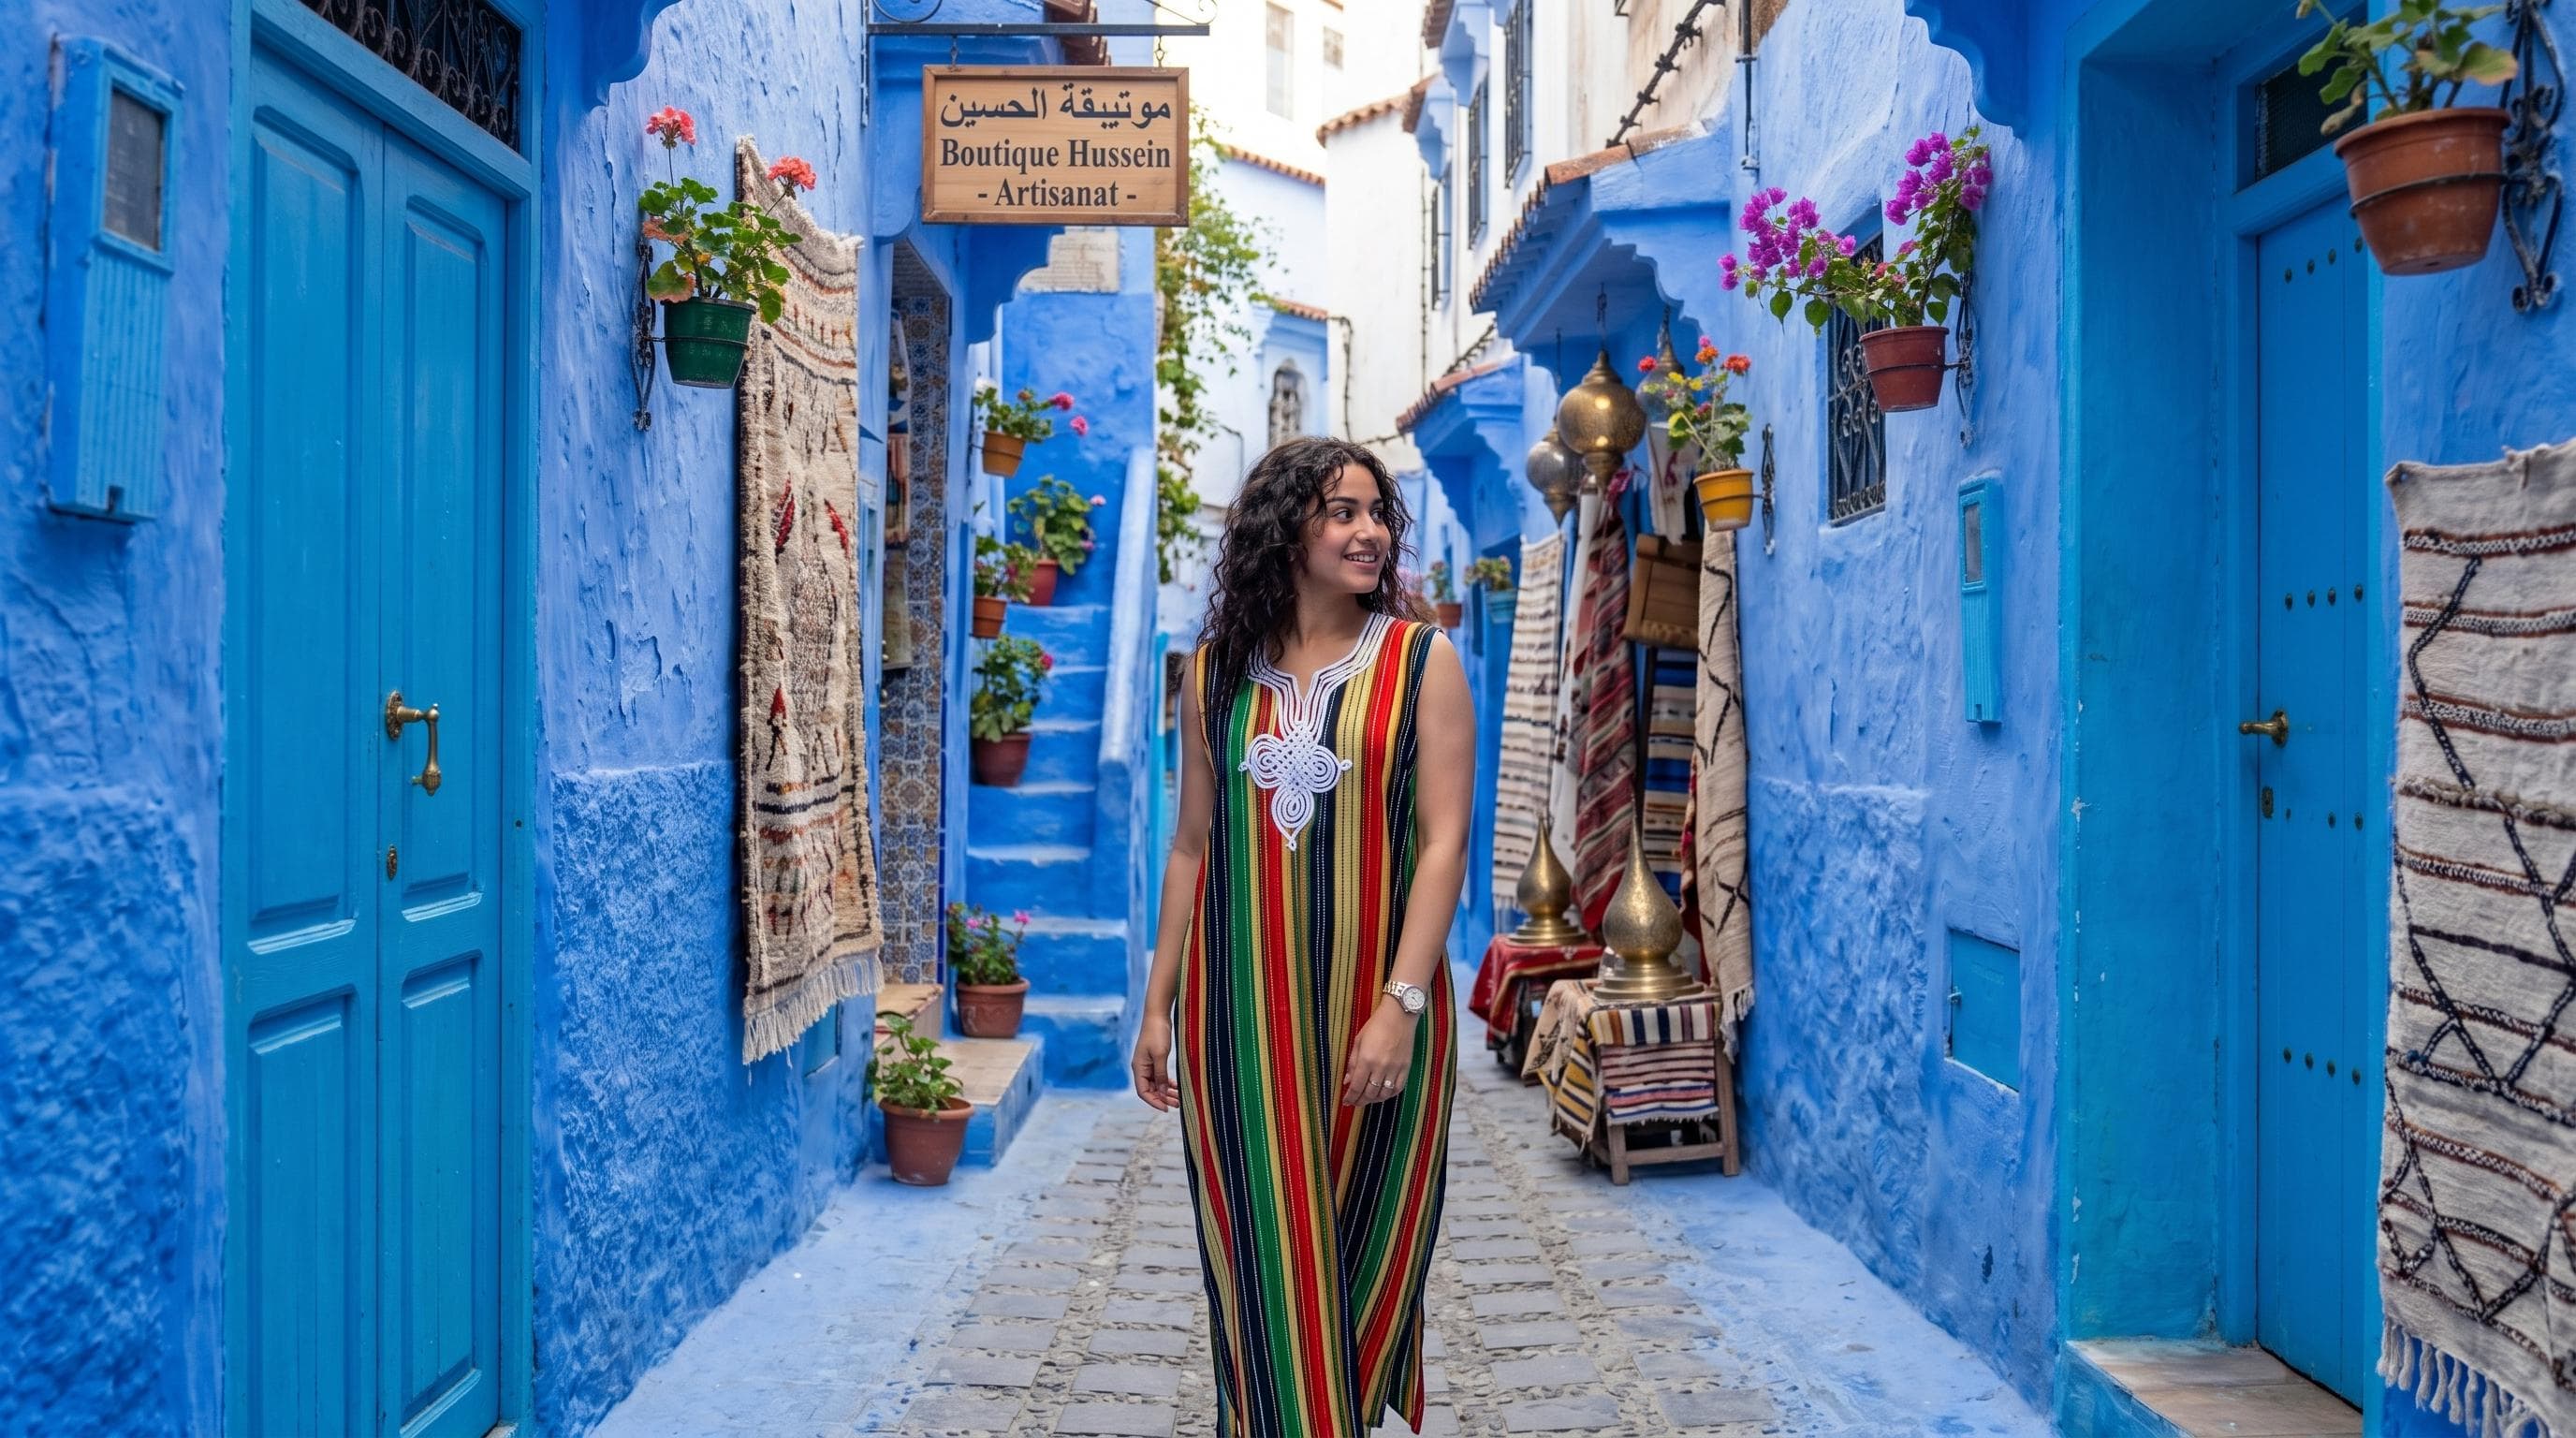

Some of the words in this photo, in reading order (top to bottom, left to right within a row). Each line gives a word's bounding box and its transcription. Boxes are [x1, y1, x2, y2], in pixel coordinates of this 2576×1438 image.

[940, 87, 1048, 128] الحسين
[940, 138, 1060, 175] Boutique
[1067, 139, 1171, 169] Hussein
[994, 178, 1120, 207] Artisanat
